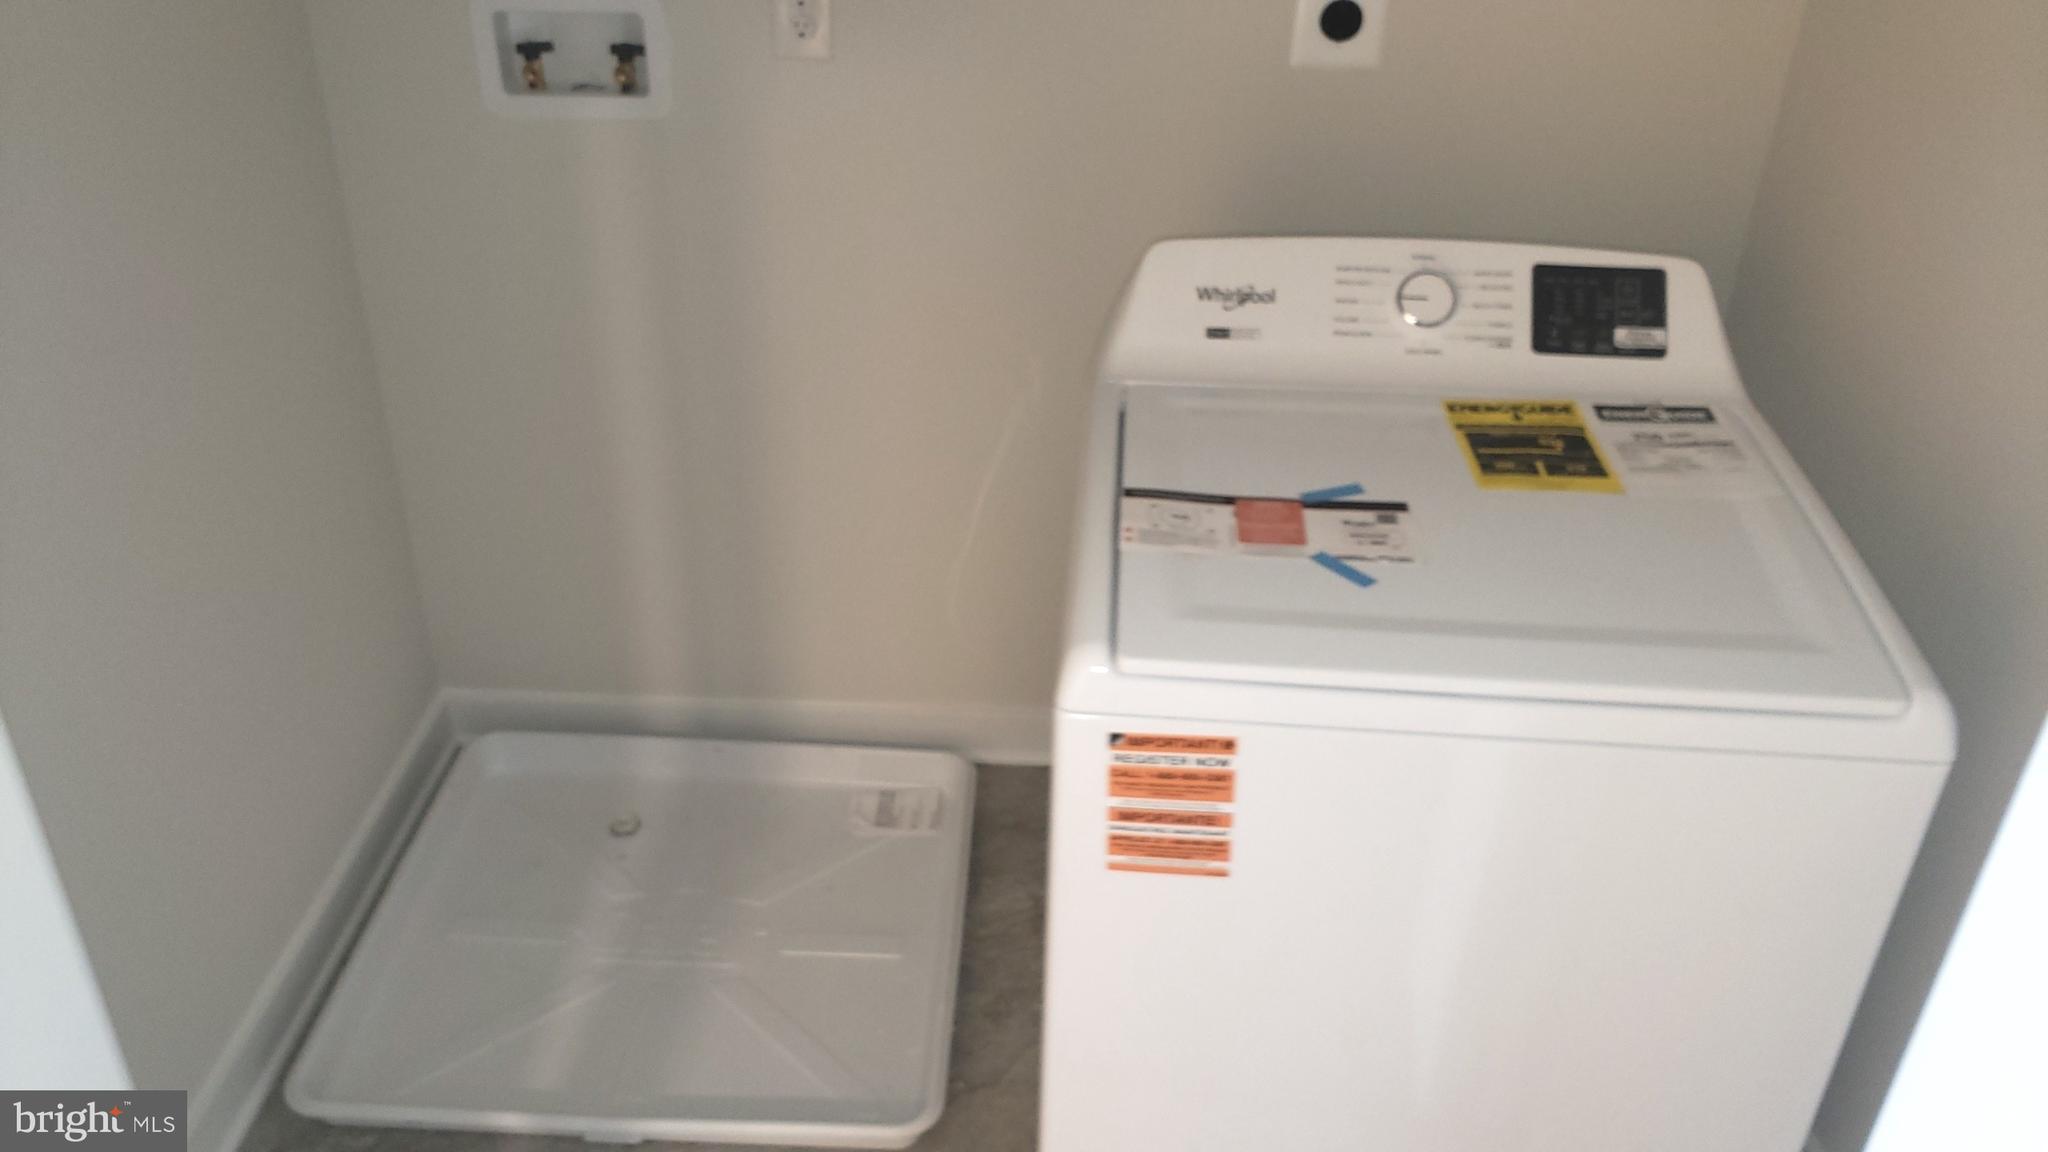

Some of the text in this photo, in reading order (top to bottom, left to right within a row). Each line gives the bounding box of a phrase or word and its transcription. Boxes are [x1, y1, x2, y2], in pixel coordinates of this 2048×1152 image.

[1196, 285, 1277, 311] Whirlpool
[1113, 753, 1230, 768] REGISTER NOW
